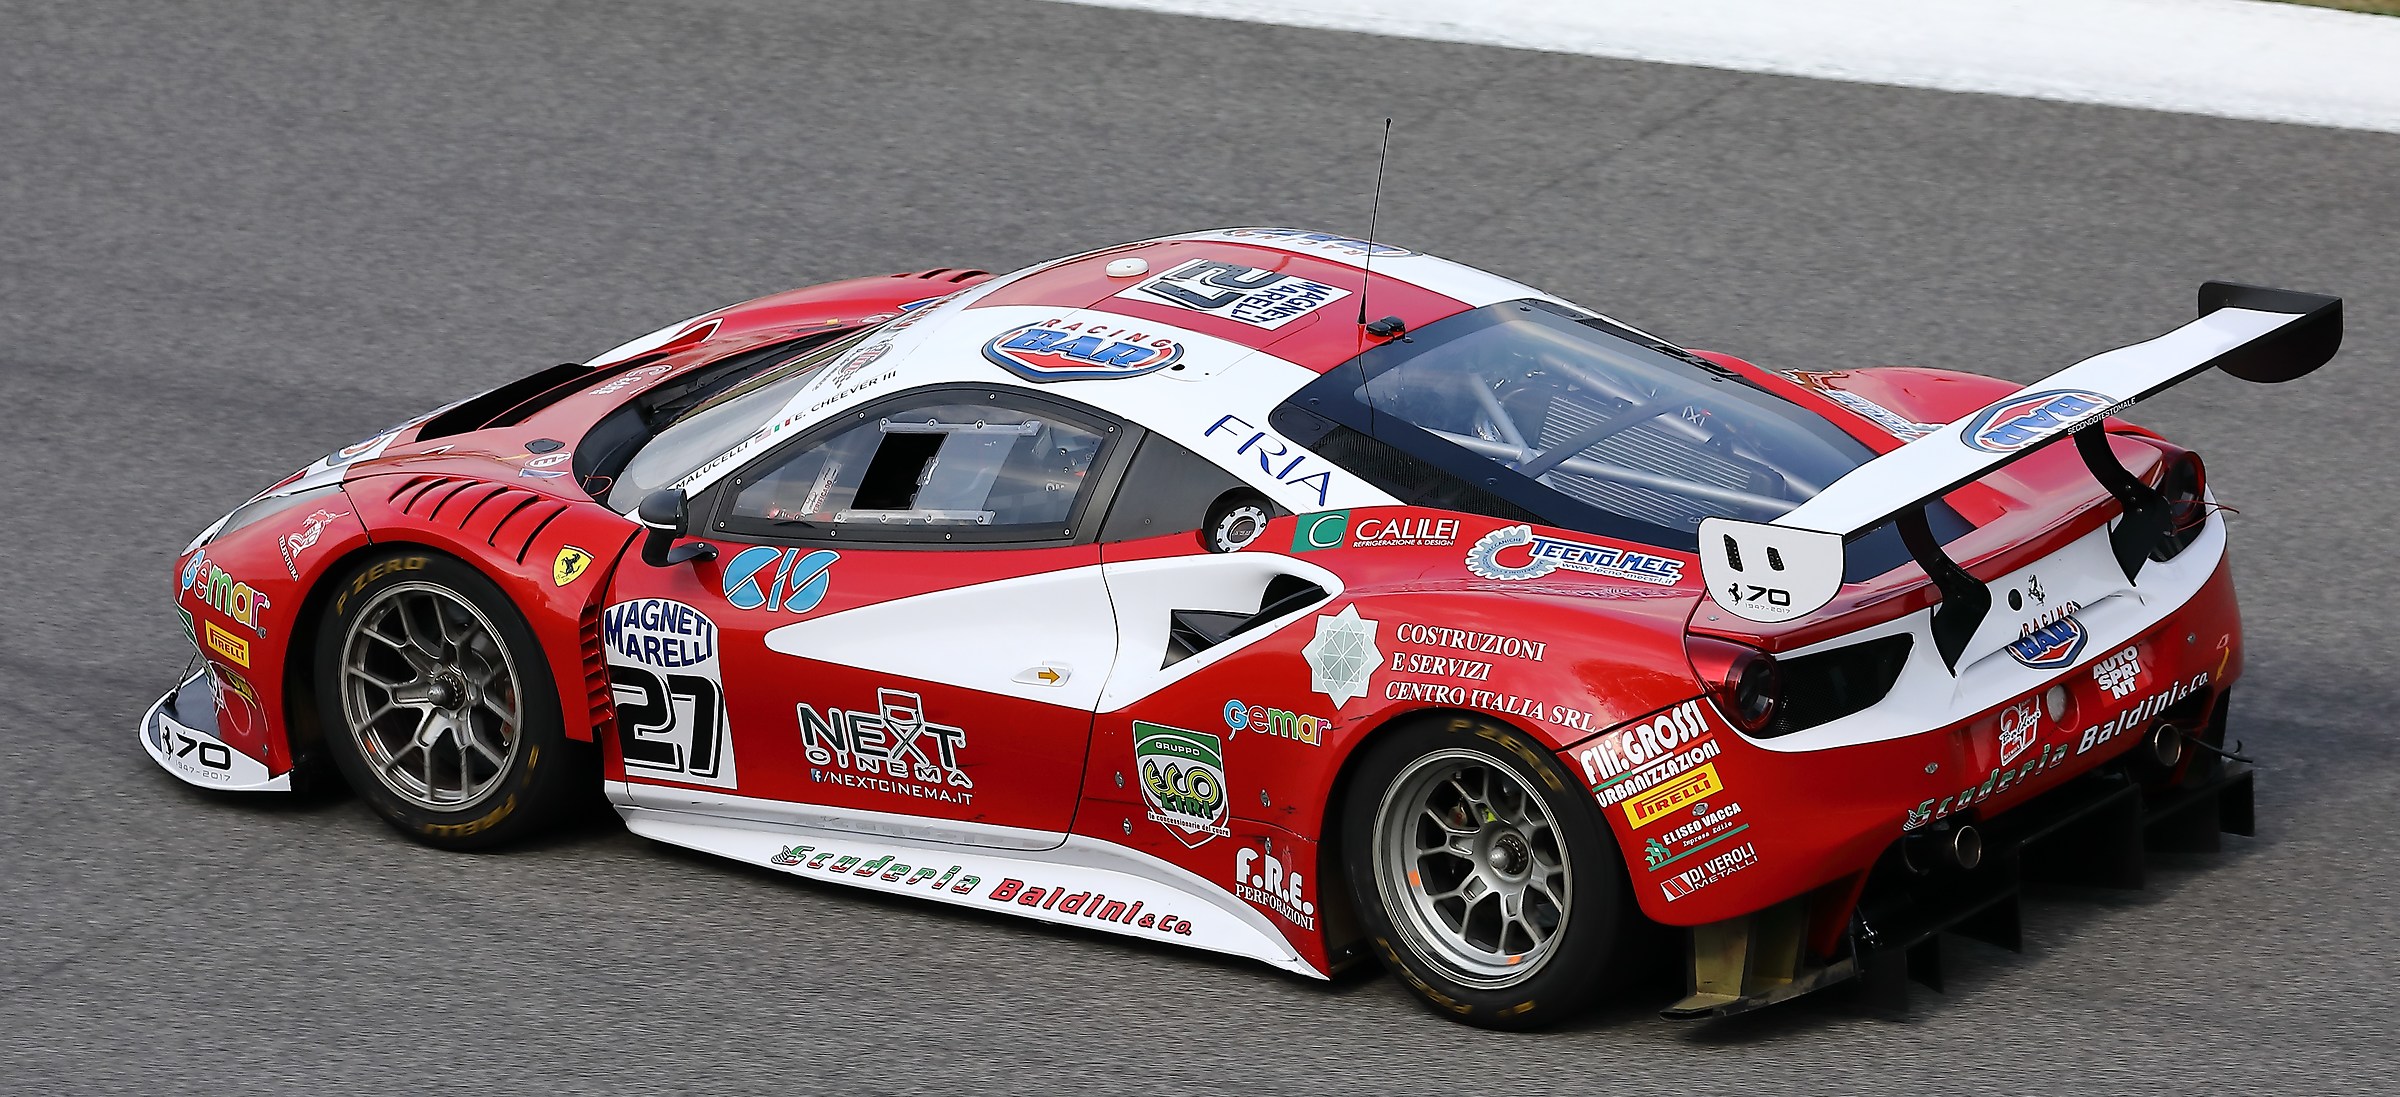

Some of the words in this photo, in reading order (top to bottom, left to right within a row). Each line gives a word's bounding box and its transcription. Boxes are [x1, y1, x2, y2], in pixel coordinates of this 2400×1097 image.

[1138, 260, 1290, 311] 27
[1246, 282, 1332, 322] MAGNETI
[1002, 329, 1159, 367] BAR
[1045, 318, 1172, 349] RACING
[811, 378, 878, 412] CHEEVER
[883, 370, 897, 380] III
[675, 441, 748, 490] MALUCELLI
[1204, 414, 1331, 507] FRIA
[278, 534, 300, 582] TELEFUTURA
[1353, 539, 1415, 548] REFRIGERAZIONE
[180, 549, 270, 631] Gemar
[352, 556, 430, 596] ZERO
[1746, 584, 1790, 607] 70
[605, 600, 712, 646] MAGNETI
[1745, 603, 1791, 614] 1947-2017
[2022, 601, 2075, 636] RACING
[210, 628, 246, 661] PIRELLI
[605, 628, 712, 667] MARELLI
[1397, 622, 1546, 662] COSTRUZIONI
[2018, 618, 2077, 660] BAR
[1391, 653, 1406, 671] E
[1407, 655, 1493, 681] SERVIZI
[2093, 645, 2138, 679] AUTO
[2098, 660, 2140, 690] SPRI
[1385, 681, 1467, 707] CENTRO
[1470, 689, 1545, 721] ITALIA
[1548, 708, 1597, 733] SRL
[2111, 677, 2136, 700] NT
[609, 664, 724, 779] 27
[797, 692, 966, 770] NEXT
[1224, 699, 1331, 746] Gemar
[176, 732, 231, 770] 70
[806, 747, 973, 788] CINEMA
[1155, 741, 1200, 756] GRUPPO
[1913, 743, 2068, 830] Scuderia
[2077, 680, 2178, 755] Baldini
[174, 759, 231, 782] 1947-2017
[1143, 758, 1223, 811] ECO
[1596, 739, 1721, 808] URBANIZZAZIONI
[1633, 772, 1711, 820] PIRELLI
[1662, 819, 1703, 846] ELISEO
[1702, 802, 1742, 828] VACCA
[1683, 832, 1710, 847] Impresa
[1236, 848, 1314, 914] F.R.E.
[1688, 865, 1705, 882] DI
[1705, 842, 1756, 874] VEROLI
[1694, 856, 1758, 890] METALLI
[783, 844, 981, 894] Scuderia
[988, 877, 1142, 925] Baldini
[1138, 913, 1155, 928] &
[1157, 915, 1193, 936] Co.
[1236, 883, 1314, 931] PERFORAZIONI
